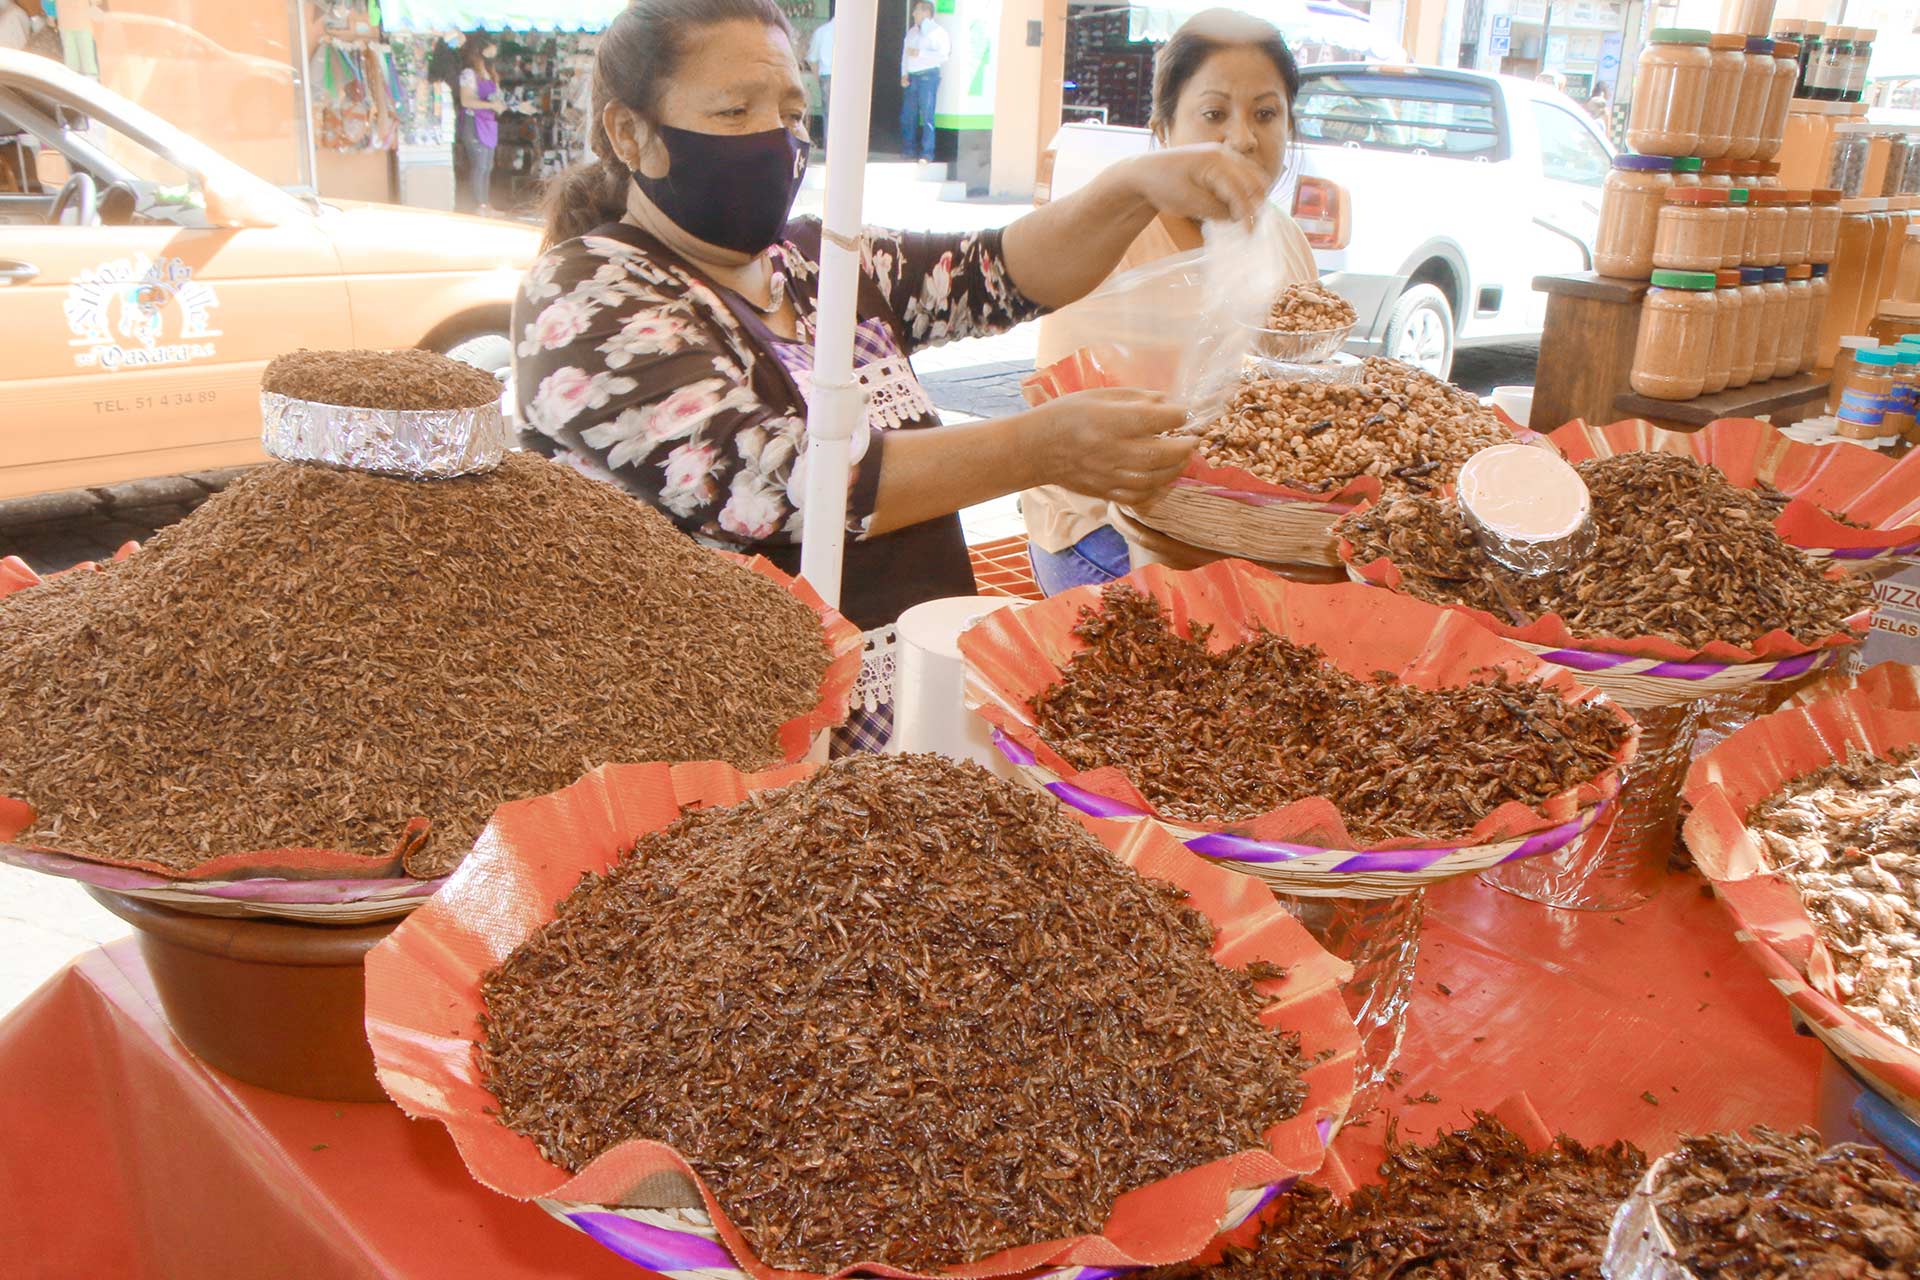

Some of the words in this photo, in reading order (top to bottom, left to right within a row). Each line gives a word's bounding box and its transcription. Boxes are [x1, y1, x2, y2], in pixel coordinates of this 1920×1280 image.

[93, 399, 129, 414] TEL.
[136, 396, 152, 409] 51
[160, 394, 169, 405] 4
[175, 392, 193, 405] 34
[199, 390, 217, 404] 89
